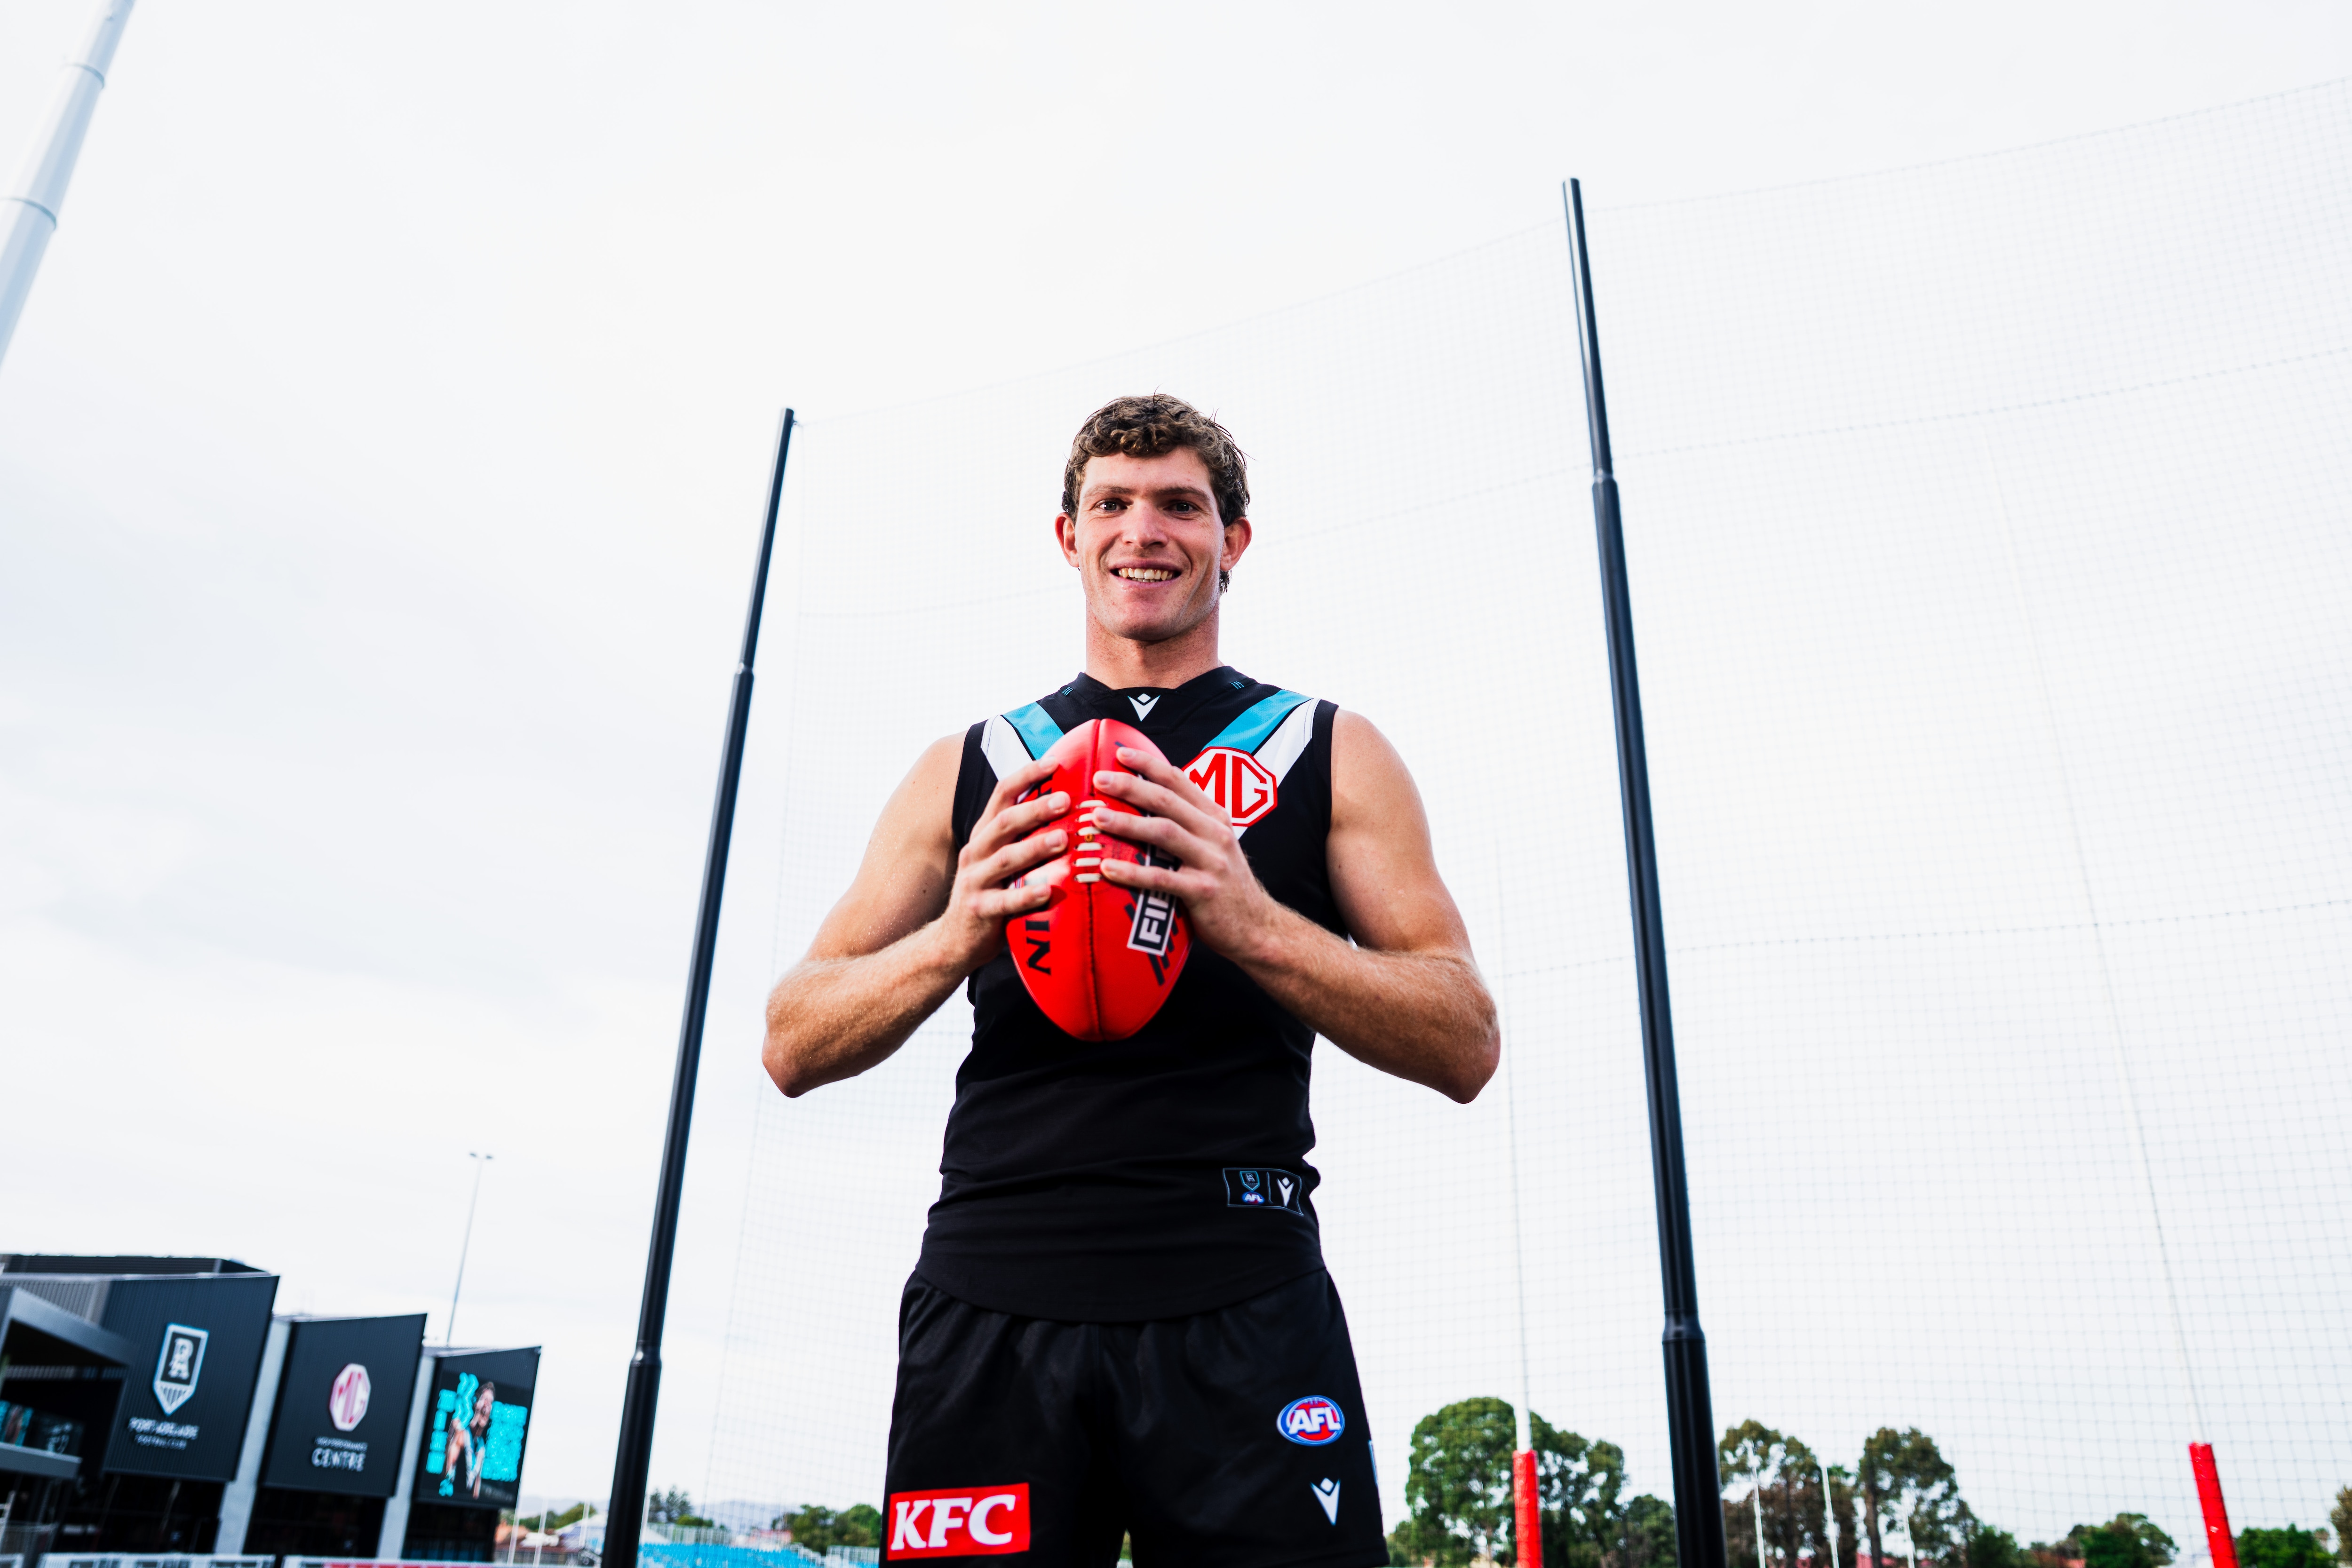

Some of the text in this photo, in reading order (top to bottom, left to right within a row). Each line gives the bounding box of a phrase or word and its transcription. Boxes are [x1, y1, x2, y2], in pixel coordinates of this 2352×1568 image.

[1189, 753, 1268, 819] MG
[1244, 1194, 1263, 1202] AFL
[1288, 1406, 1342, 1435] AFL
[311, 1447, 366, 1472] CENTRE
[890, 1494, 1017, 1551] KFC
